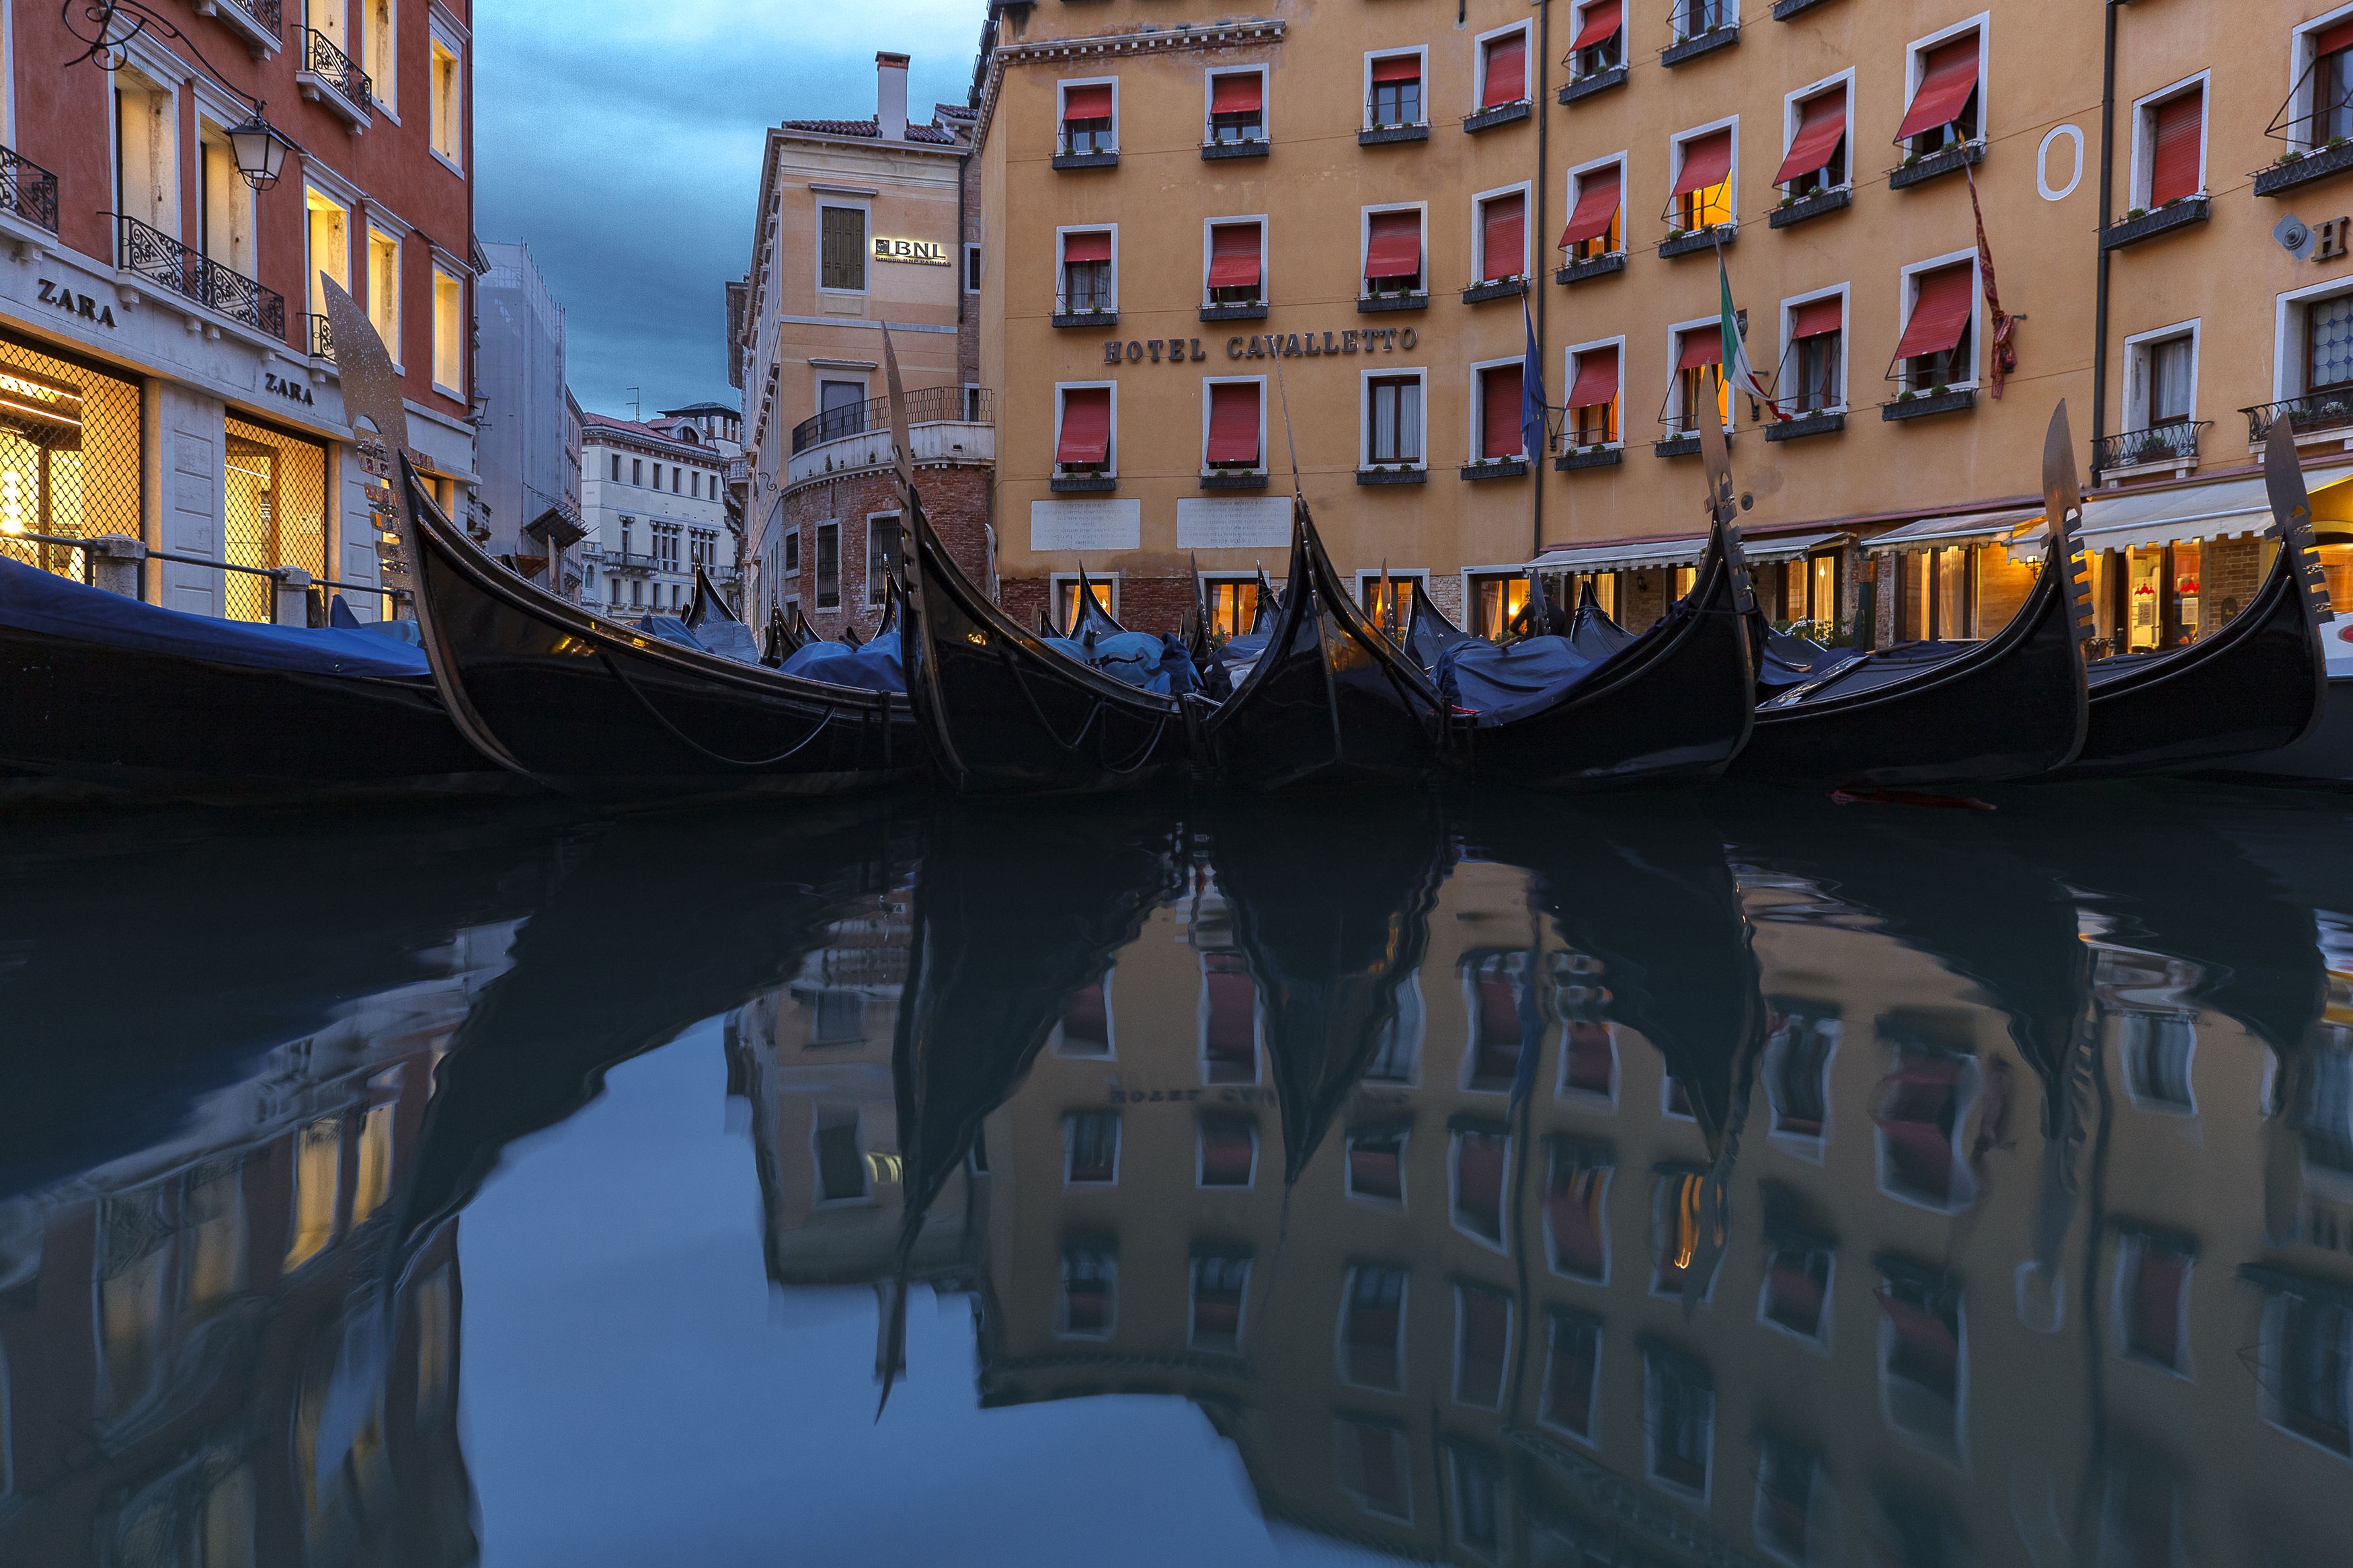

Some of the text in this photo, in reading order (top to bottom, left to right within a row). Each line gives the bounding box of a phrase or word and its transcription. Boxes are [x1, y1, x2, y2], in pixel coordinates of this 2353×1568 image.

[895, 241, 947, 260] BNL
[920, 259, 951, 267] PARIBAS
[38, 278, 118, 328] ZARA
[1103, 326, 1419, 364] HOTEL CAVALLETTO
[266, 372, 315, 407] ZARA
